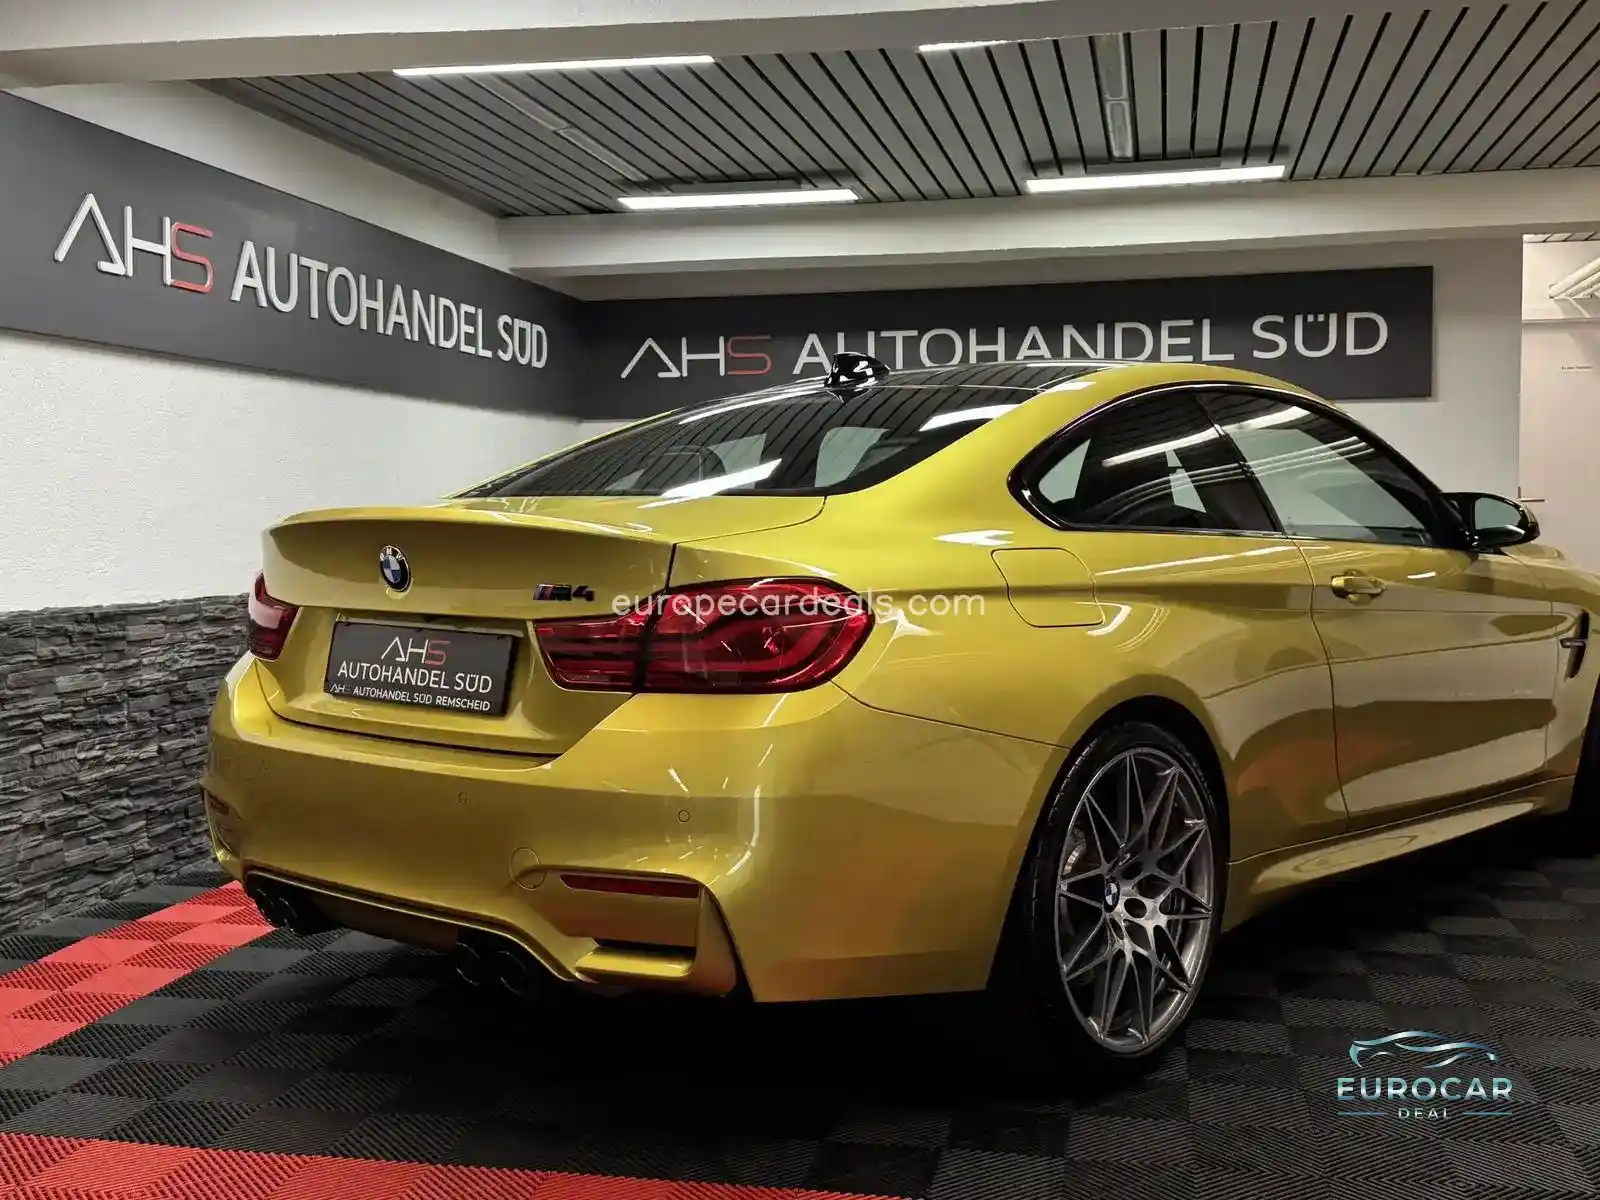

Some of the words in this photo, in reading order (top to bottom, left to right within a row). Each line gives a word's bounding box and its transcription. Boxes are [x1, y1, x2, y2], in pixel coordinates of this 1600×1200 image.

[54, 193, 214, 294] AHS
[230, 240, 492, 359] AUTOHANDEL
[497, 314, 549, 369] SÜD
[620, 335, 772, 379] AHS
[1251, 311, 1389, 360] SÜD
[381, 636, 451, 666] AHS
[337, 660, 450, 690] AUTOHANDEL
[453, 672, 493, 694] SÜD
[352, 686, 412, 703] AUTOHANDEL
[412, 692, 433, 704] SÜD
[435, 695, 491, 711] REMSCHEID
